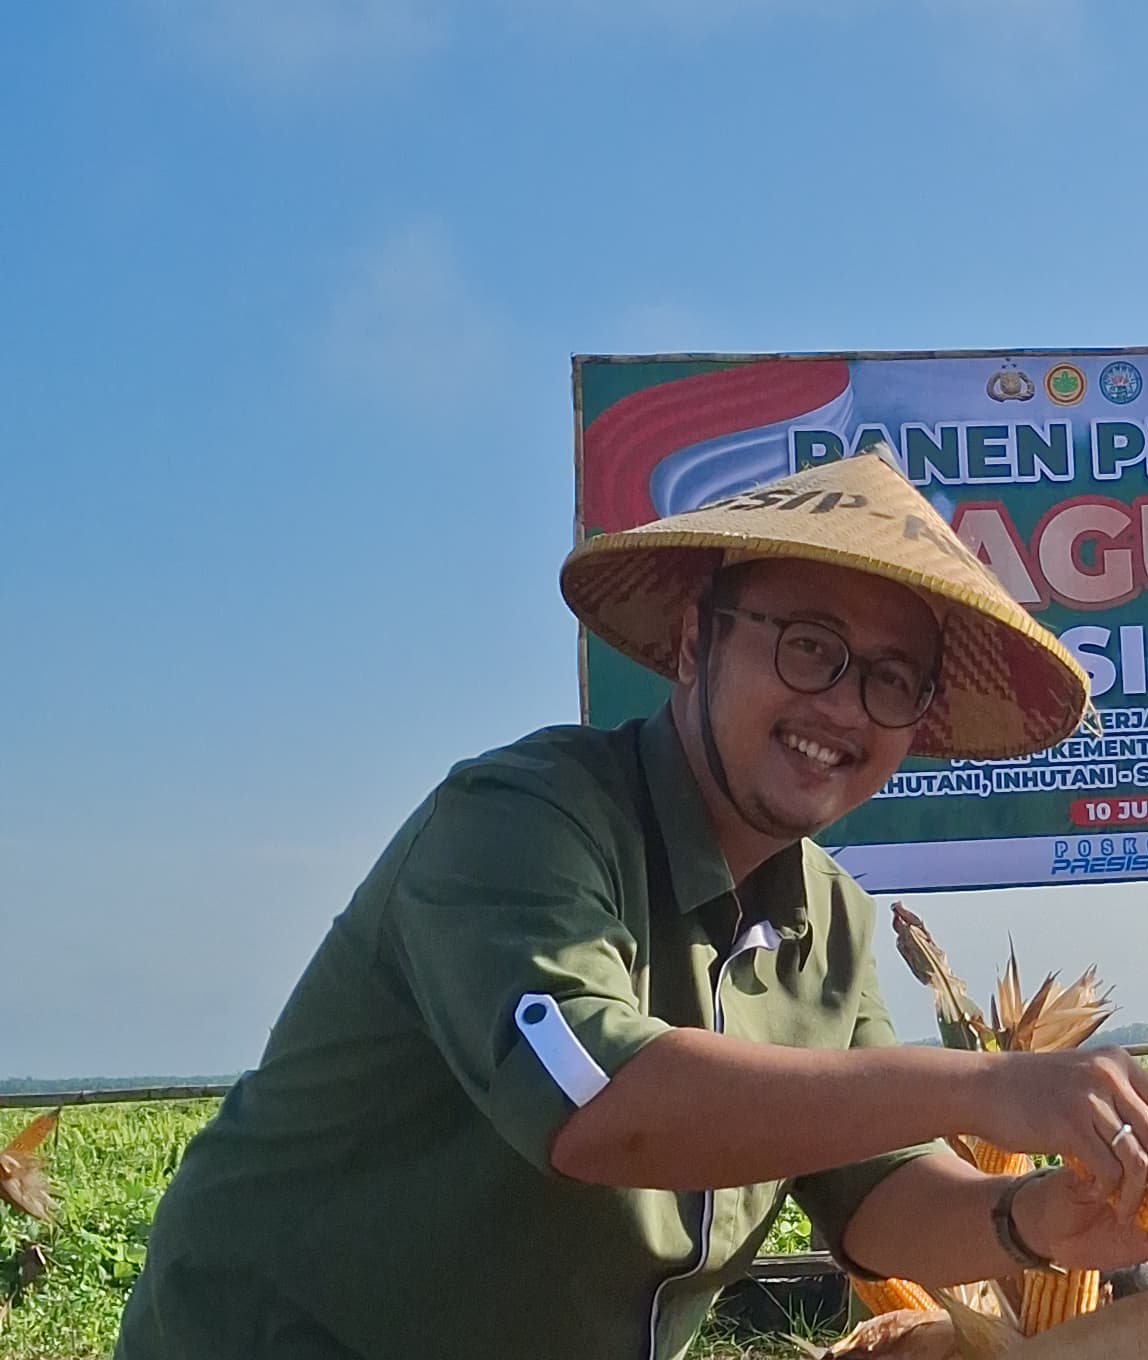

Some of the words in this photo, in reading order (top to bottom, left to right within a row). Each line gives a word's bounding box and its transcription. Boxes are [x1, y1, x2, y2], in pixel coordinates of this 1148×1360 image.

[872, 769, 991, 798] HUTANI,
[992, 763, 1116, 790] INHUTANI
[1085, 802, 1112, 821] 10
